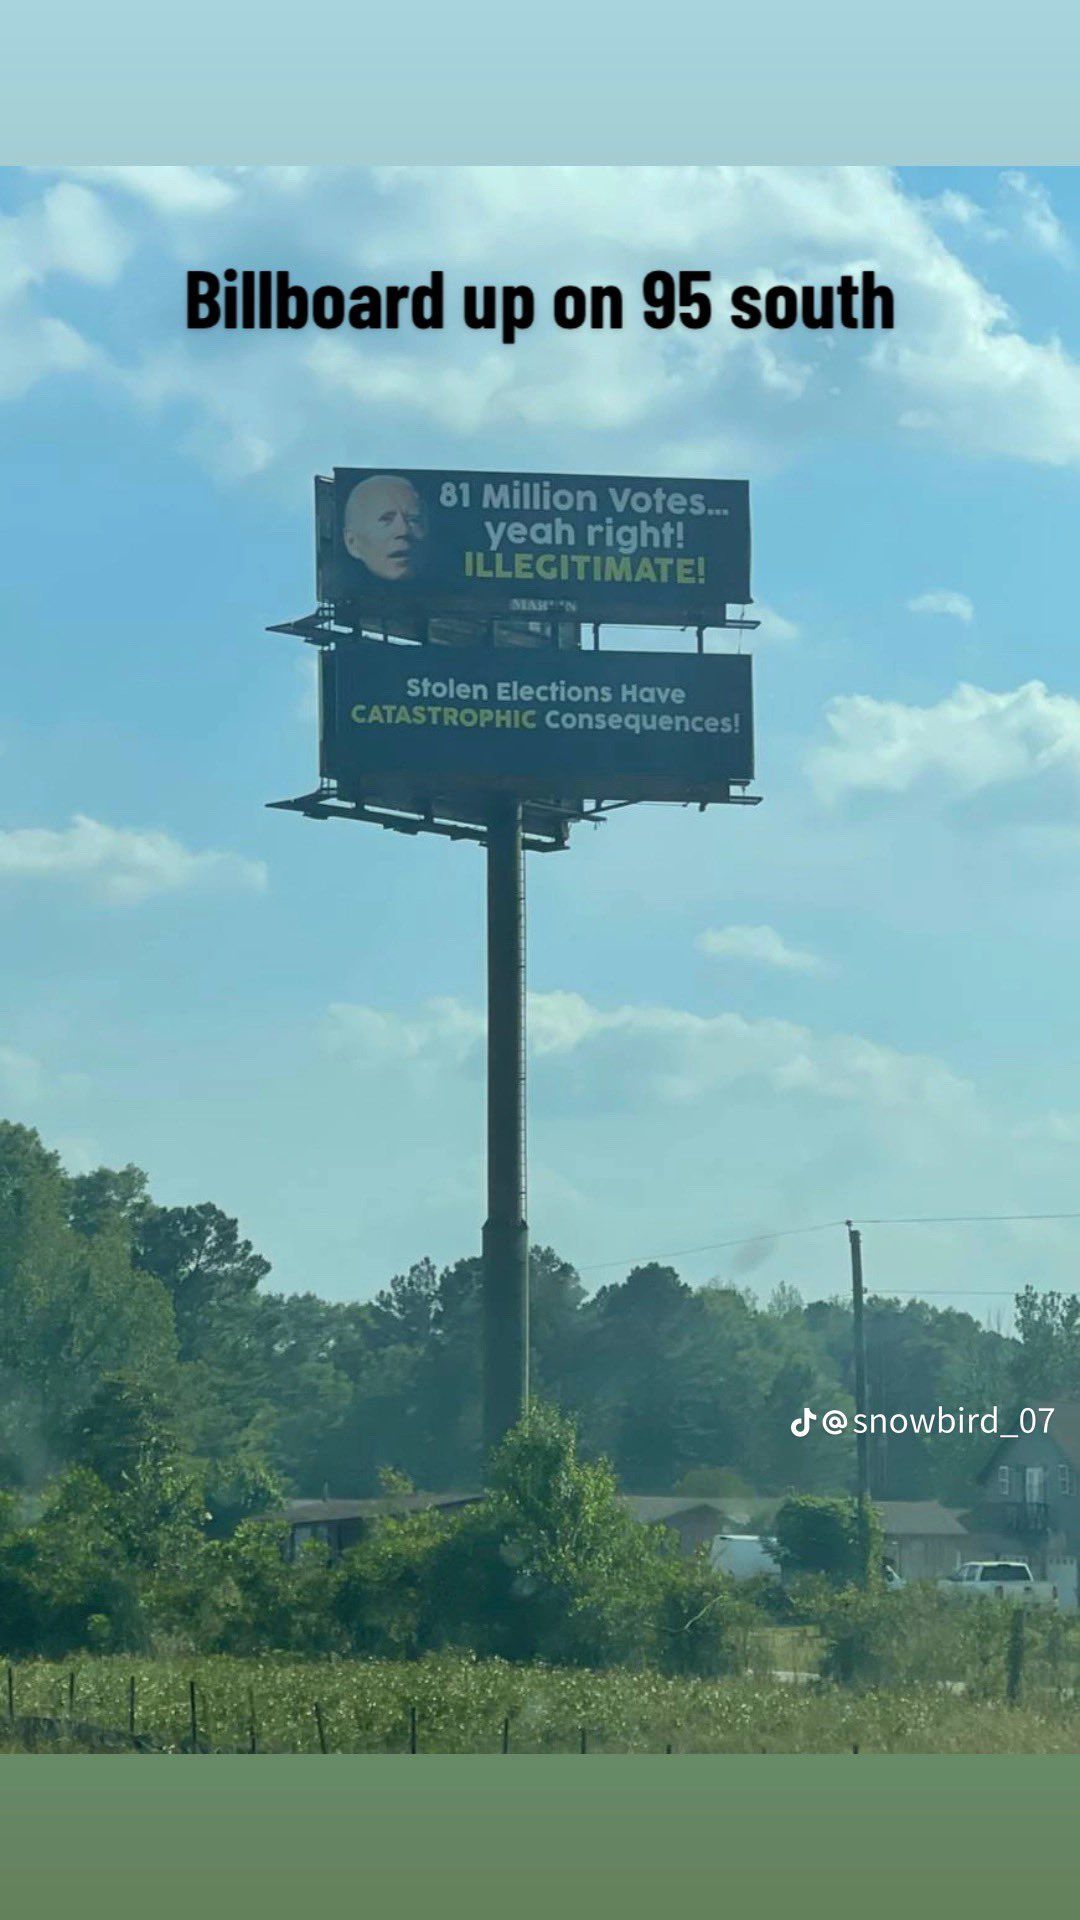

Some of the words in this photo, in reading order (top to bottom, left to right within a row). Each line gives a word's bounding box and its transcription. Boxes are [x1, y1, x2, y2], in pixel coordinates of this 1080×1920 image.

[439, 482, 470, 508] 81
[483, 481, 597, 512] Million
[609, 487, 729, 517] Votes...
[484, 518, 574, 551] yeah
[587, 518, 685, 554] right!
[464, 551, 706, 584] ILLEGITIMATE!
[510, 598, 577, 612] MARN
[407, 677, 488, 700] Stolen
[497, 680, 612, 703] Elections
[621, 683, 686, 704] Have
[351, 704, 537, 729] CATASTROPHIC
[545, 709, 740, 735] Consequences!
